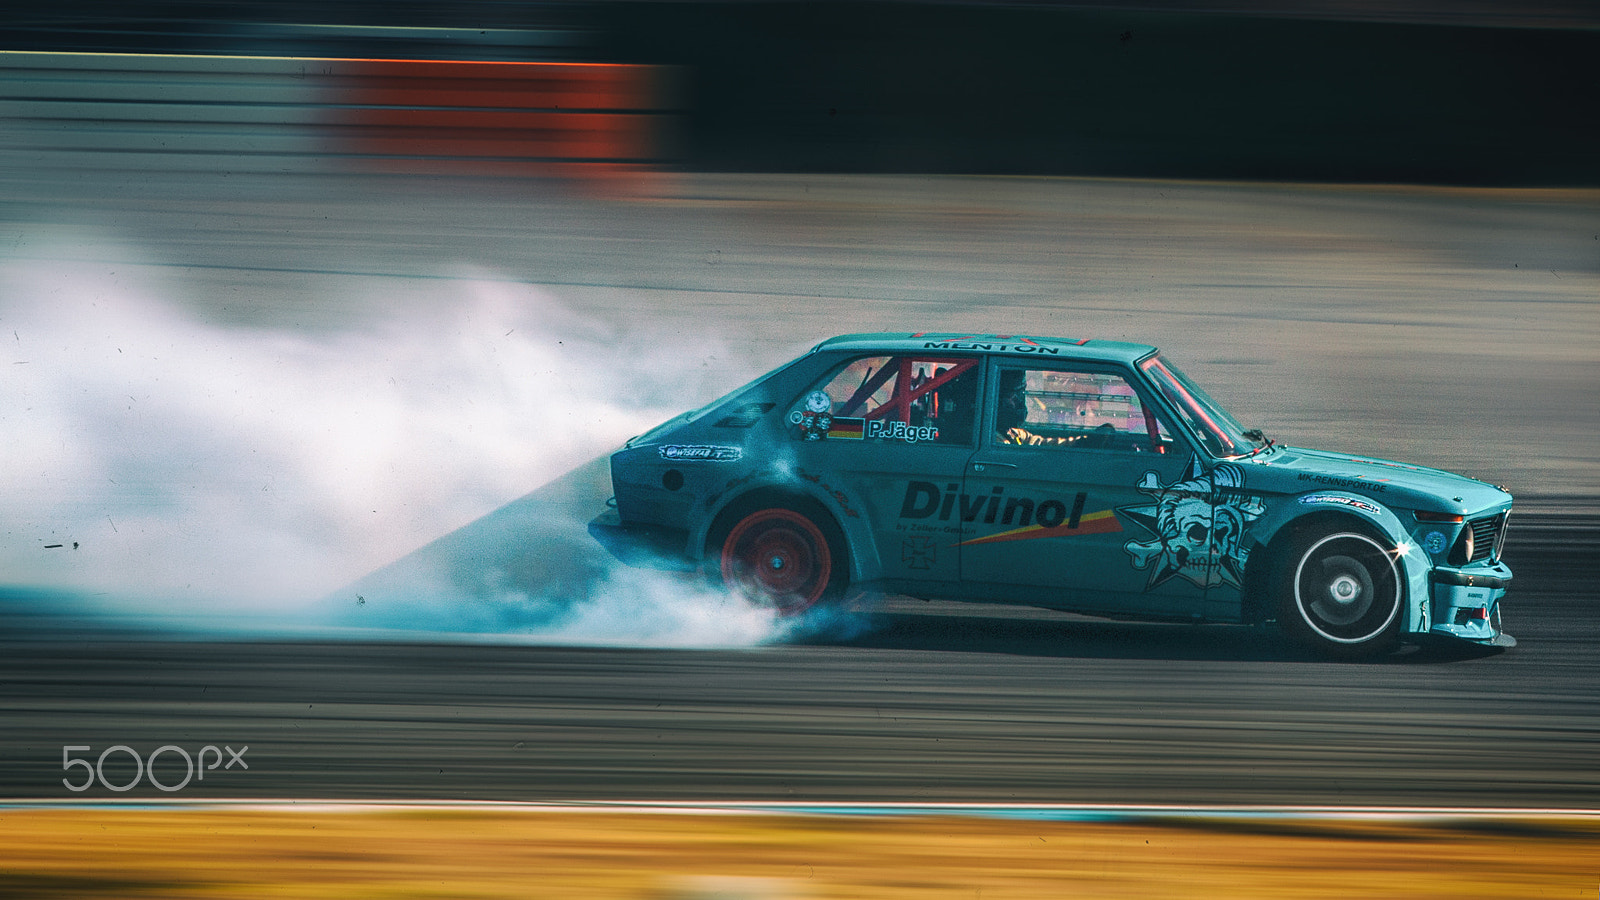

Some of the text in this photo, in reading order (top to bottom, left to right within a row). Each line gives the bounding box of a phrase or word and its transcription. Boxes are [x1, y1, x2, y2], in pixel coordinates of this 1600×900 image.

[924, 342, 1059, 355] MENTON
[868, 420, 938, 443] P.Jäger
[1297, 473, 1388, 493] MK-RENNSPORT.DE
[900, 480, 1088, 530] Divinol
